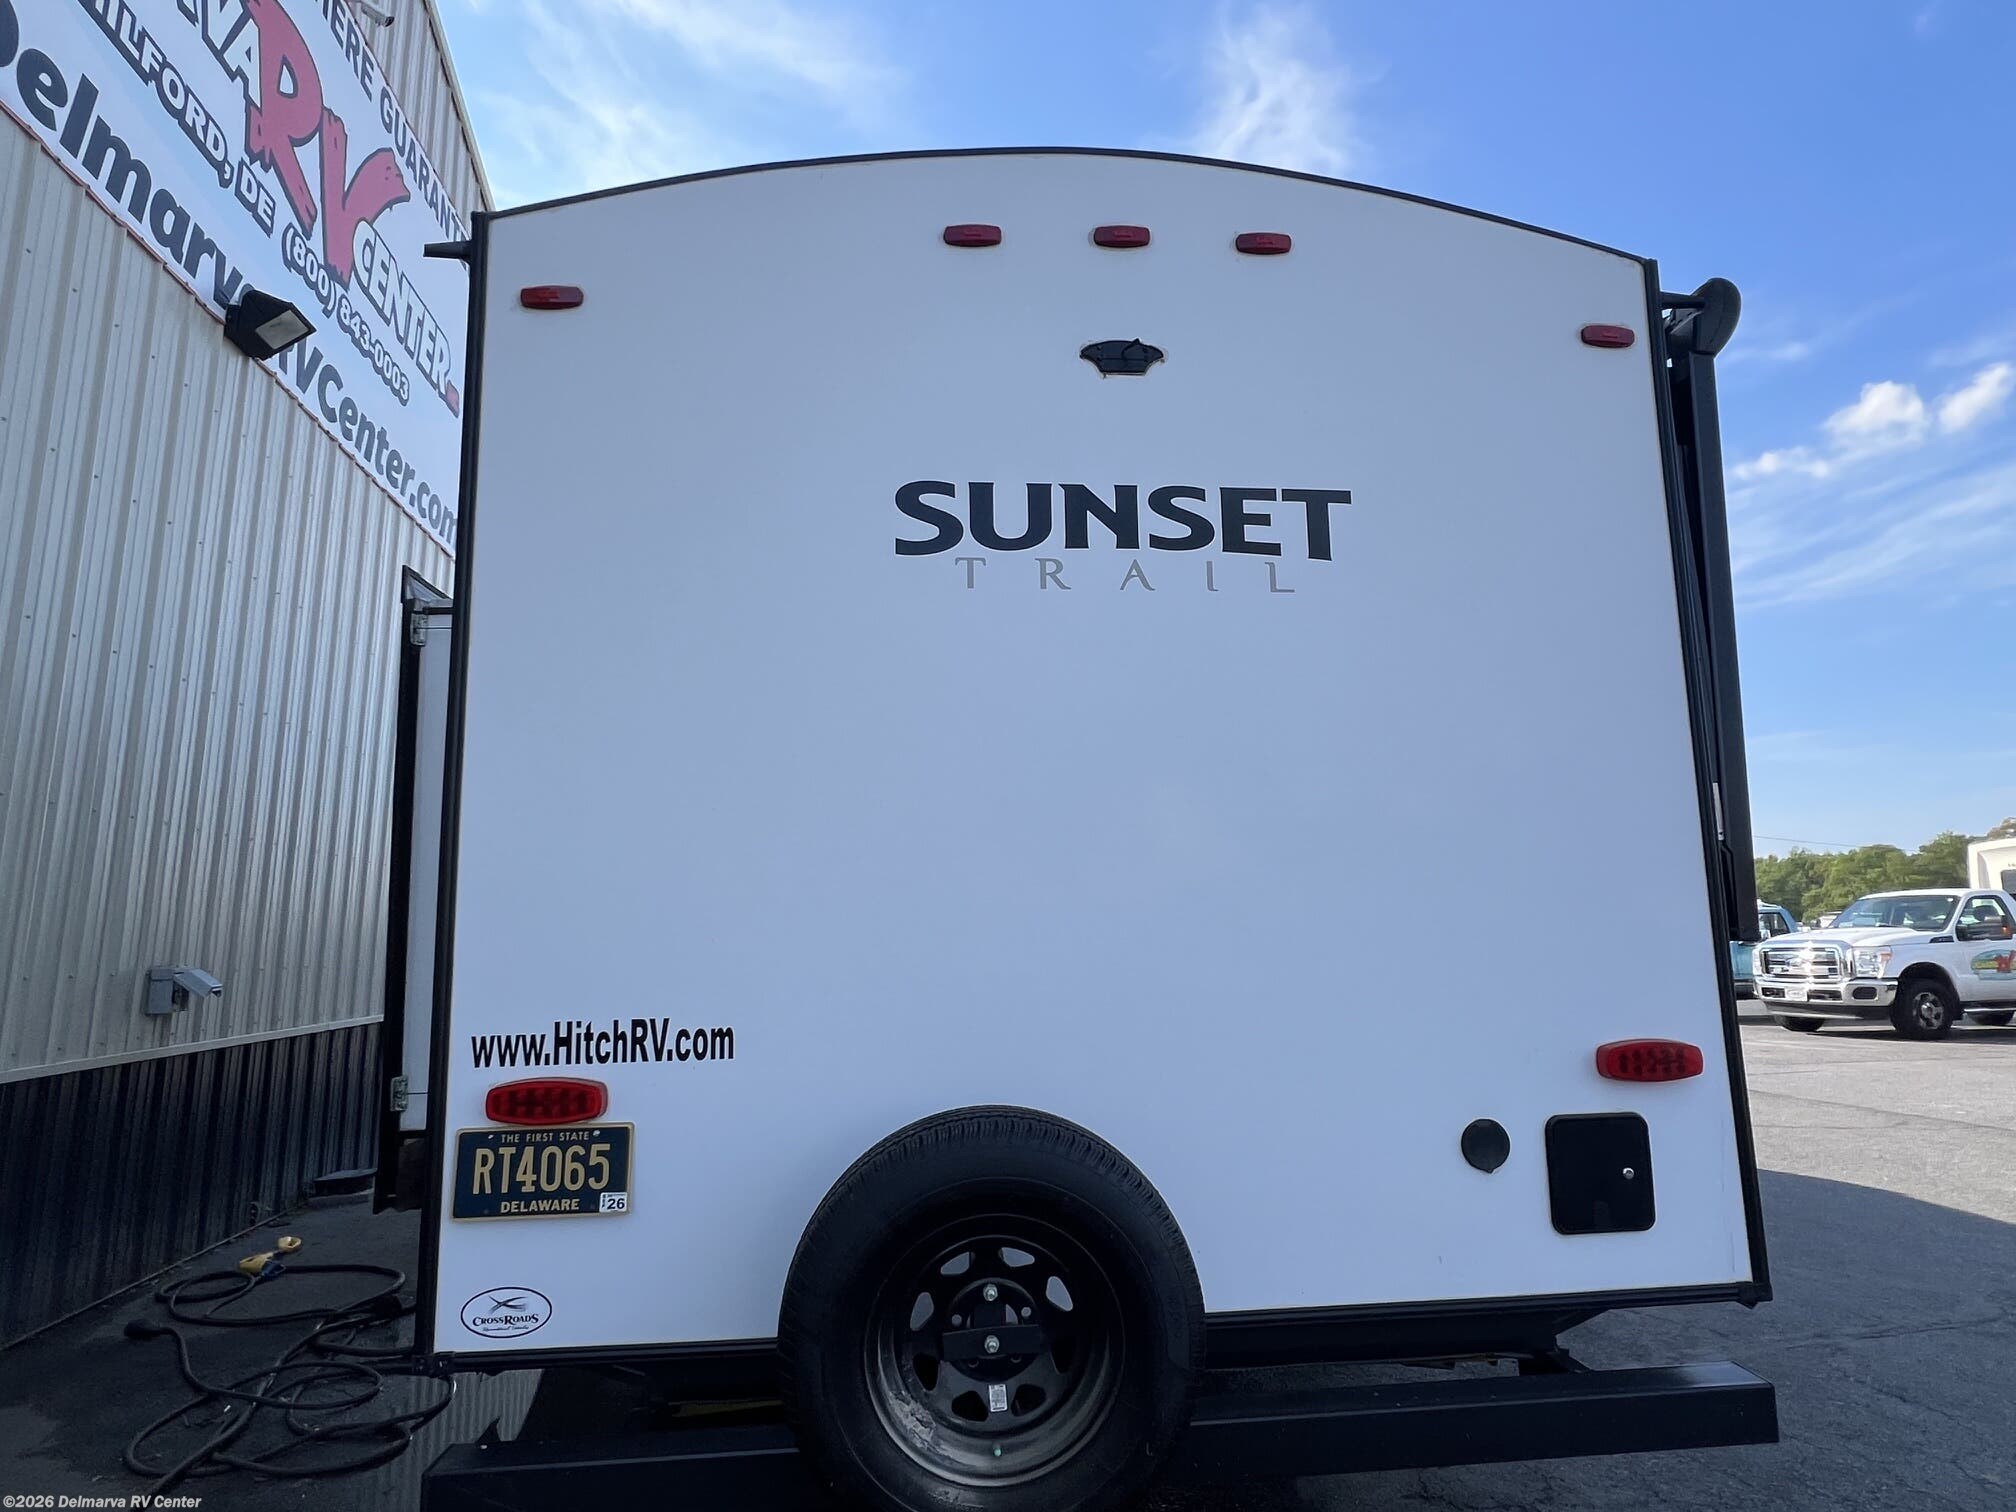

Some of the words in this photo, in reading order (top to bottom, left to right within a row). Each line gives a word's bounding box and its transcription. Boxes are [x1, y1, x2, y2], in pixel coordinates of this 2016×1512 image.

[80, 0, 234, 188] ILFORD,
[235, 158, 276, 238] DE
[352, 217, 452, 395] CENTER
[894, 480, 1352, 561] SUNSET
[954, 557, 1295, 593] TRAIL
[471, 1018, 734, 1068] www.HitchRV.com
[501, 1133, 519, 1143] THE
[526, 1132, 553, 1142] FIRST
[559, 1130, 589, 1141] STATE
[473, 1143, 611, 1195] RT4065
[501, 1198, 580, 1214] DELAWARE
[607, 1198, 625, 1210] 26
